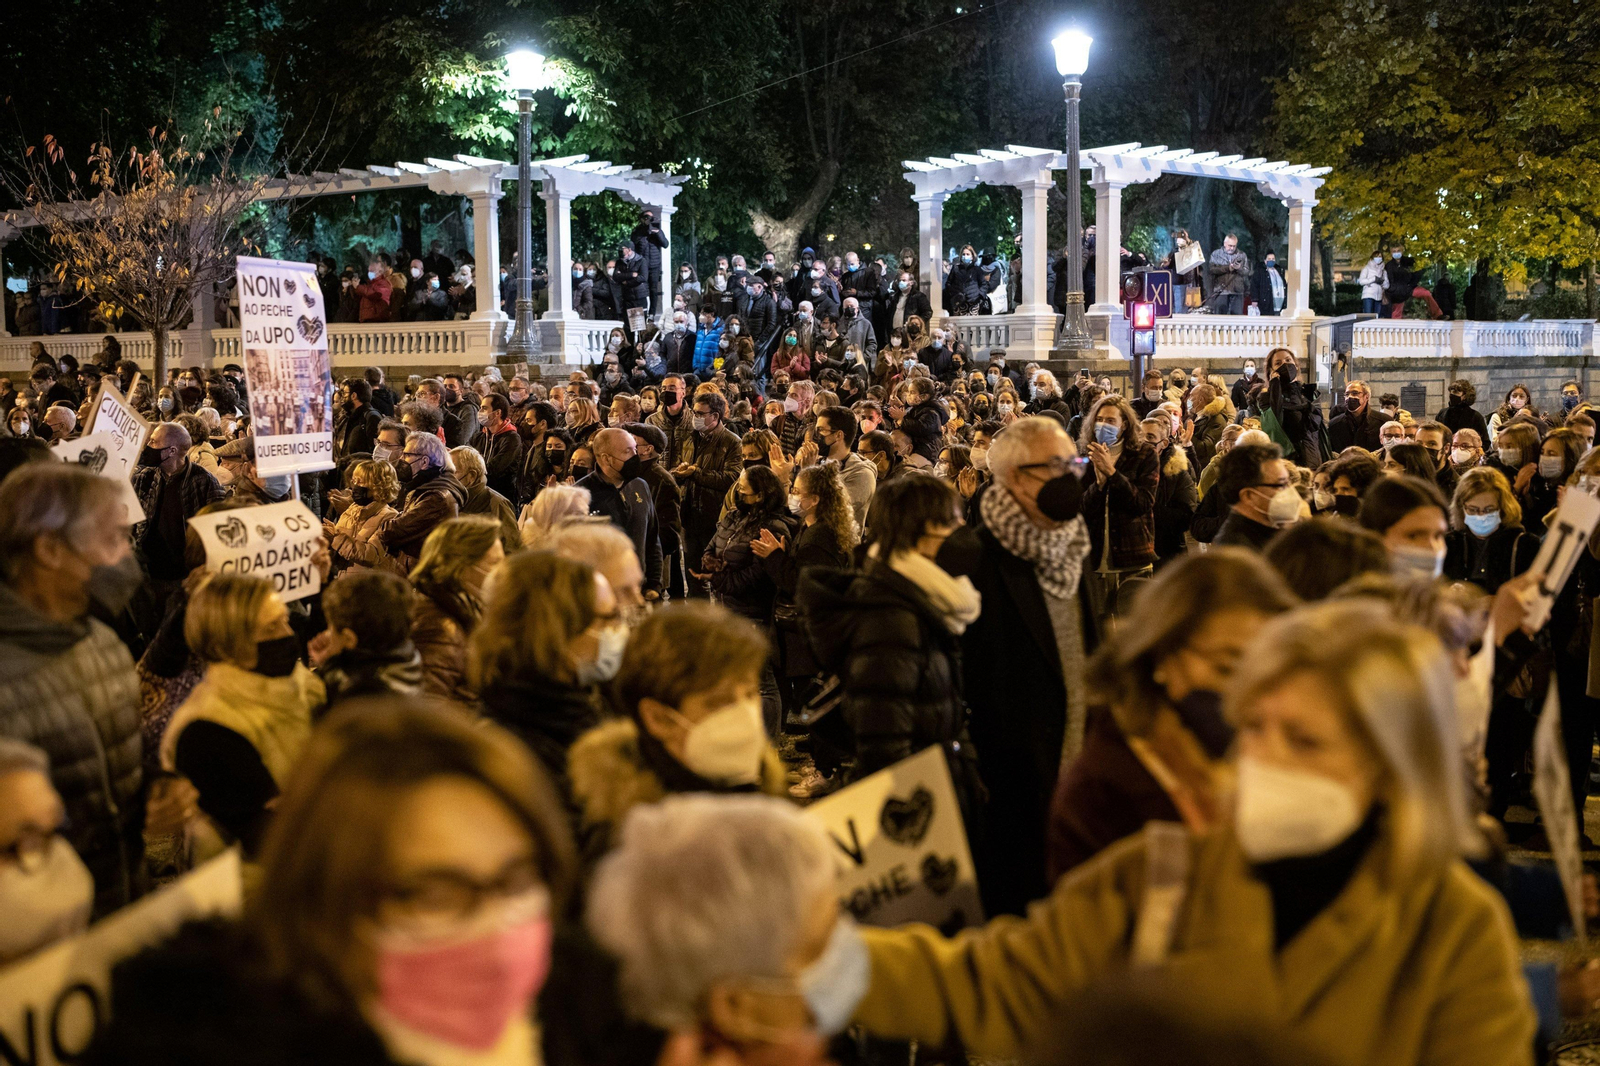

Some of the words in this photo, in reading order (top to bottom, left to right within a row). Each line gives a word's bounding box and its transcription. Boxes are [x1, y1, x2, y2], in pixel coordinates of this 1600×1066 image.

[242, 275, 280, 298] NON
[1151, 283, 1168, 306] XI
[244, 303, 258, 315] AO
[261, 304, 293, 317] PECHE
[246, 329, 260, 343] DA
[263, 326, 294, 344] UPO
[101, 396, 141, 446] CULTURA
[257, 442, 310, 458] QUEREMOS
[312, 440, 332, 453] UPO
[284, 514, 310, 532] OS
[220, 539, 311, 575] CIDADÁNS
[267, 563, 312, 593] DEN
